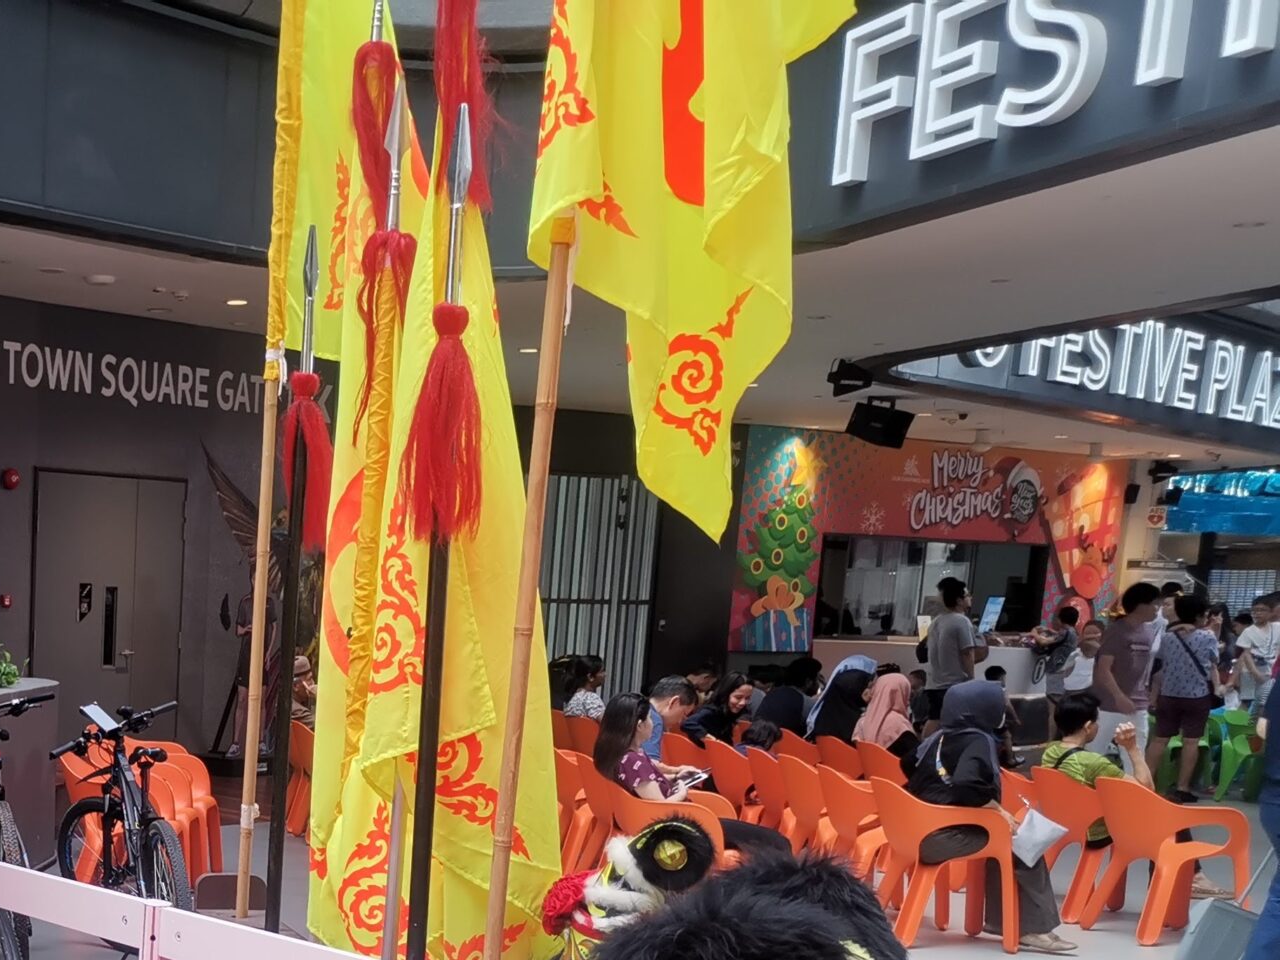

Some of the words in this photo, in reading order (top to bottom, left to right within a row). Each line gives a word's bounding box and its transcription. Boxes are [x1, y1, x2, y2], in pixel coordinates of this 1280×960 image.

[2, 340, 94, 394] TOWN
[100, 353, 210, 408] SQUARE
[216, 370, 265, 414] GAT
[1023, 319, 1206, 411] FESTIVE
[1206, 338, 1280, 429] PLA
[932, 450, 989, 488] Merry
